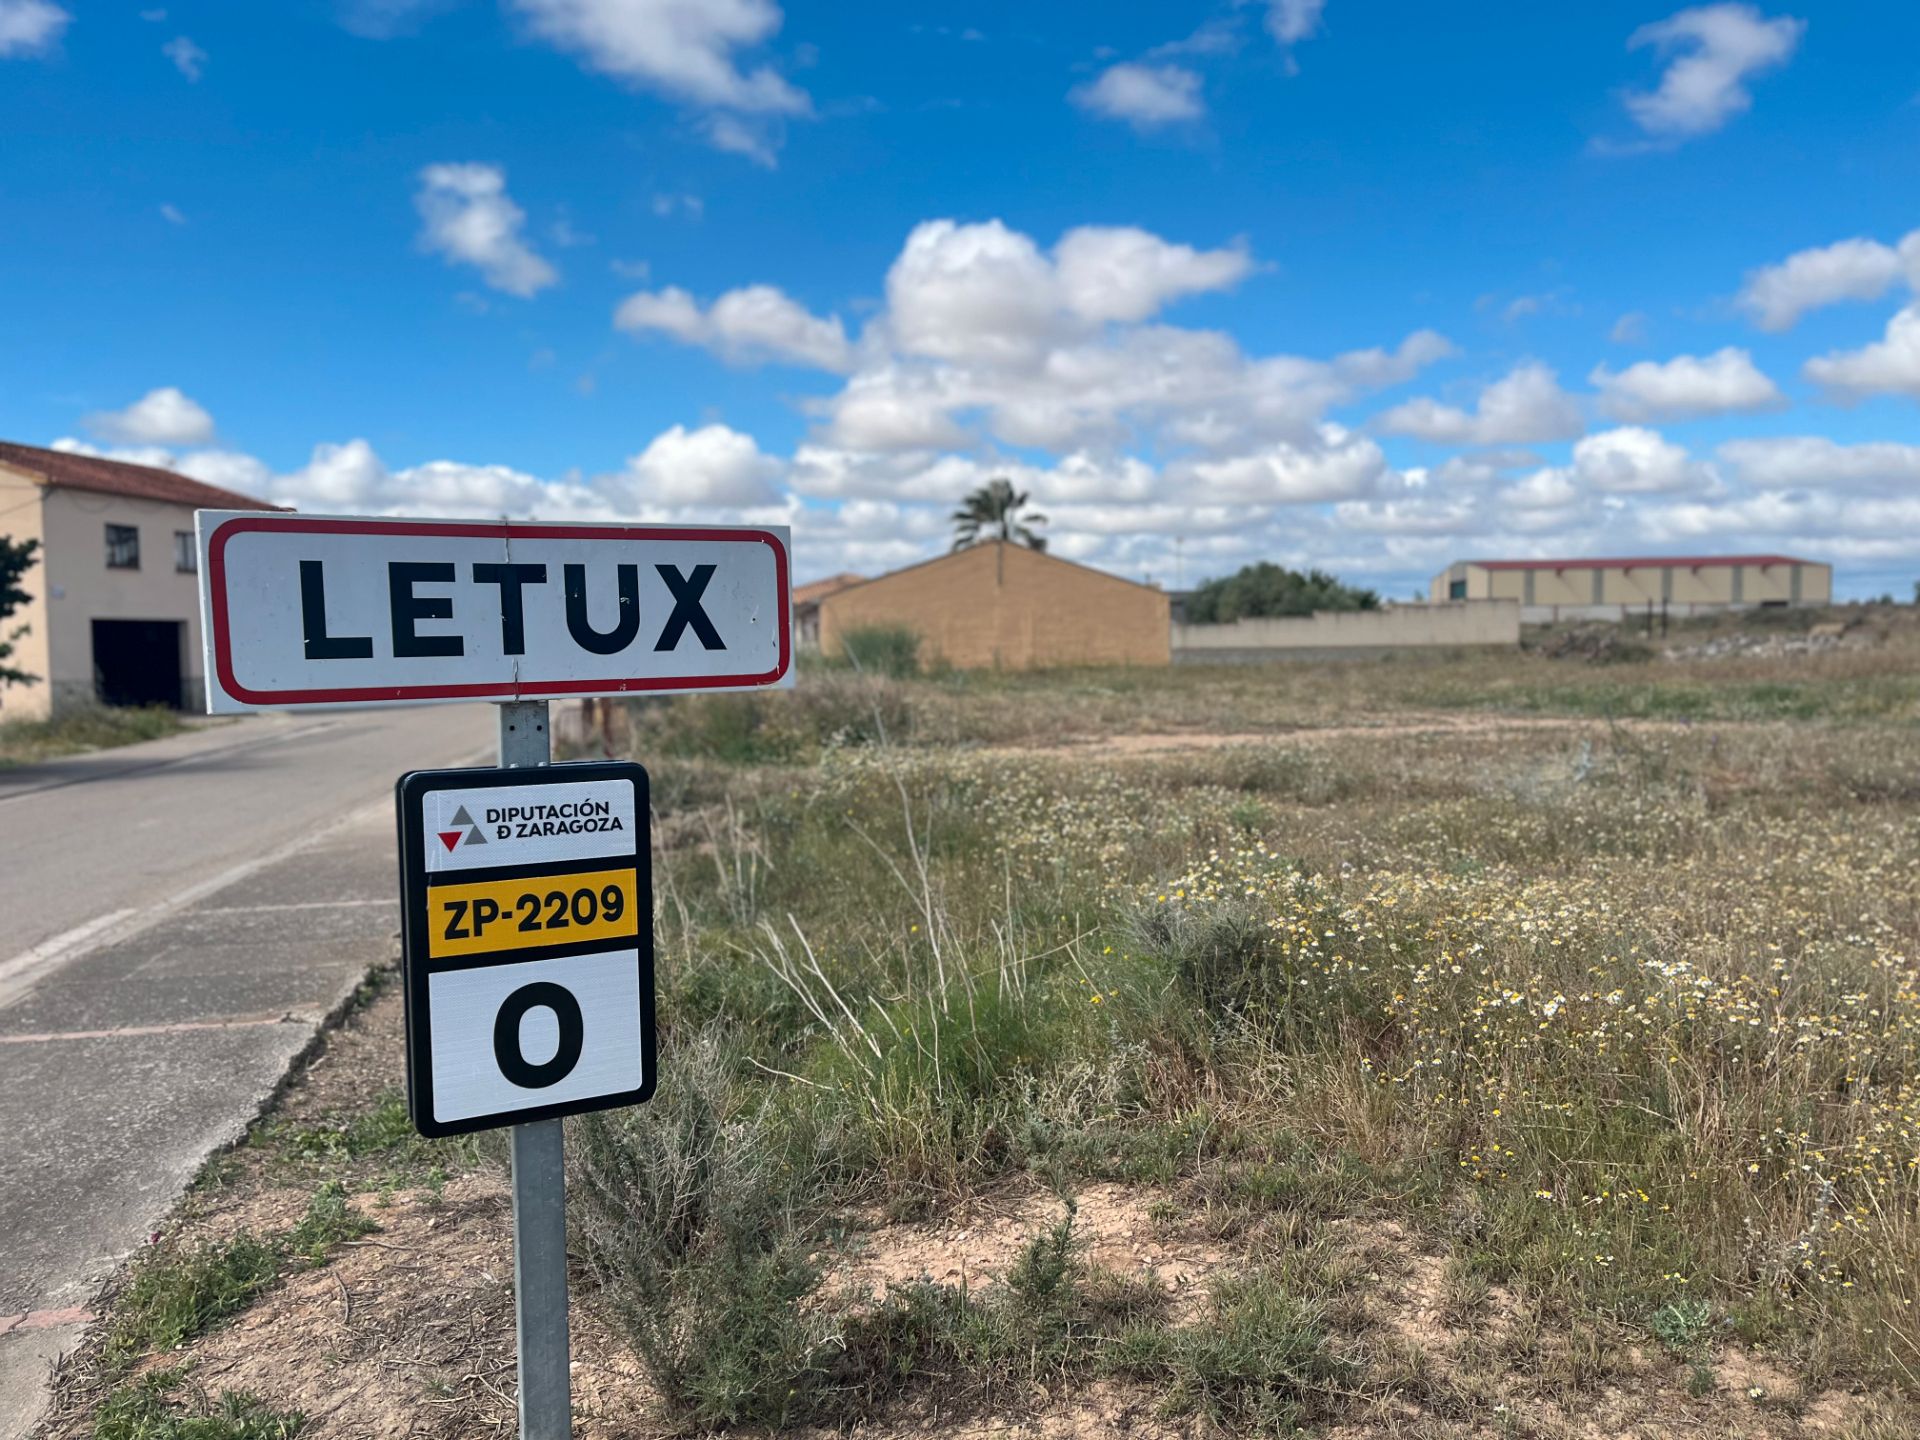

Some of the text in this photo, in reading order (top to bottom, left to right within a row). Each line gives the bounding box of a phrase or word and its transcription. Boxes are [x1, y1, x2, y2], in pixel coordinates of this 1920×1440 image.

[300, 560, 727, 660] LETUX
[486, 798, 610, 824] DIPUTACIÓN
[516, 817, 623, 839] ZARAGOZA
[443, 884, 625, 940] ZP-2209
